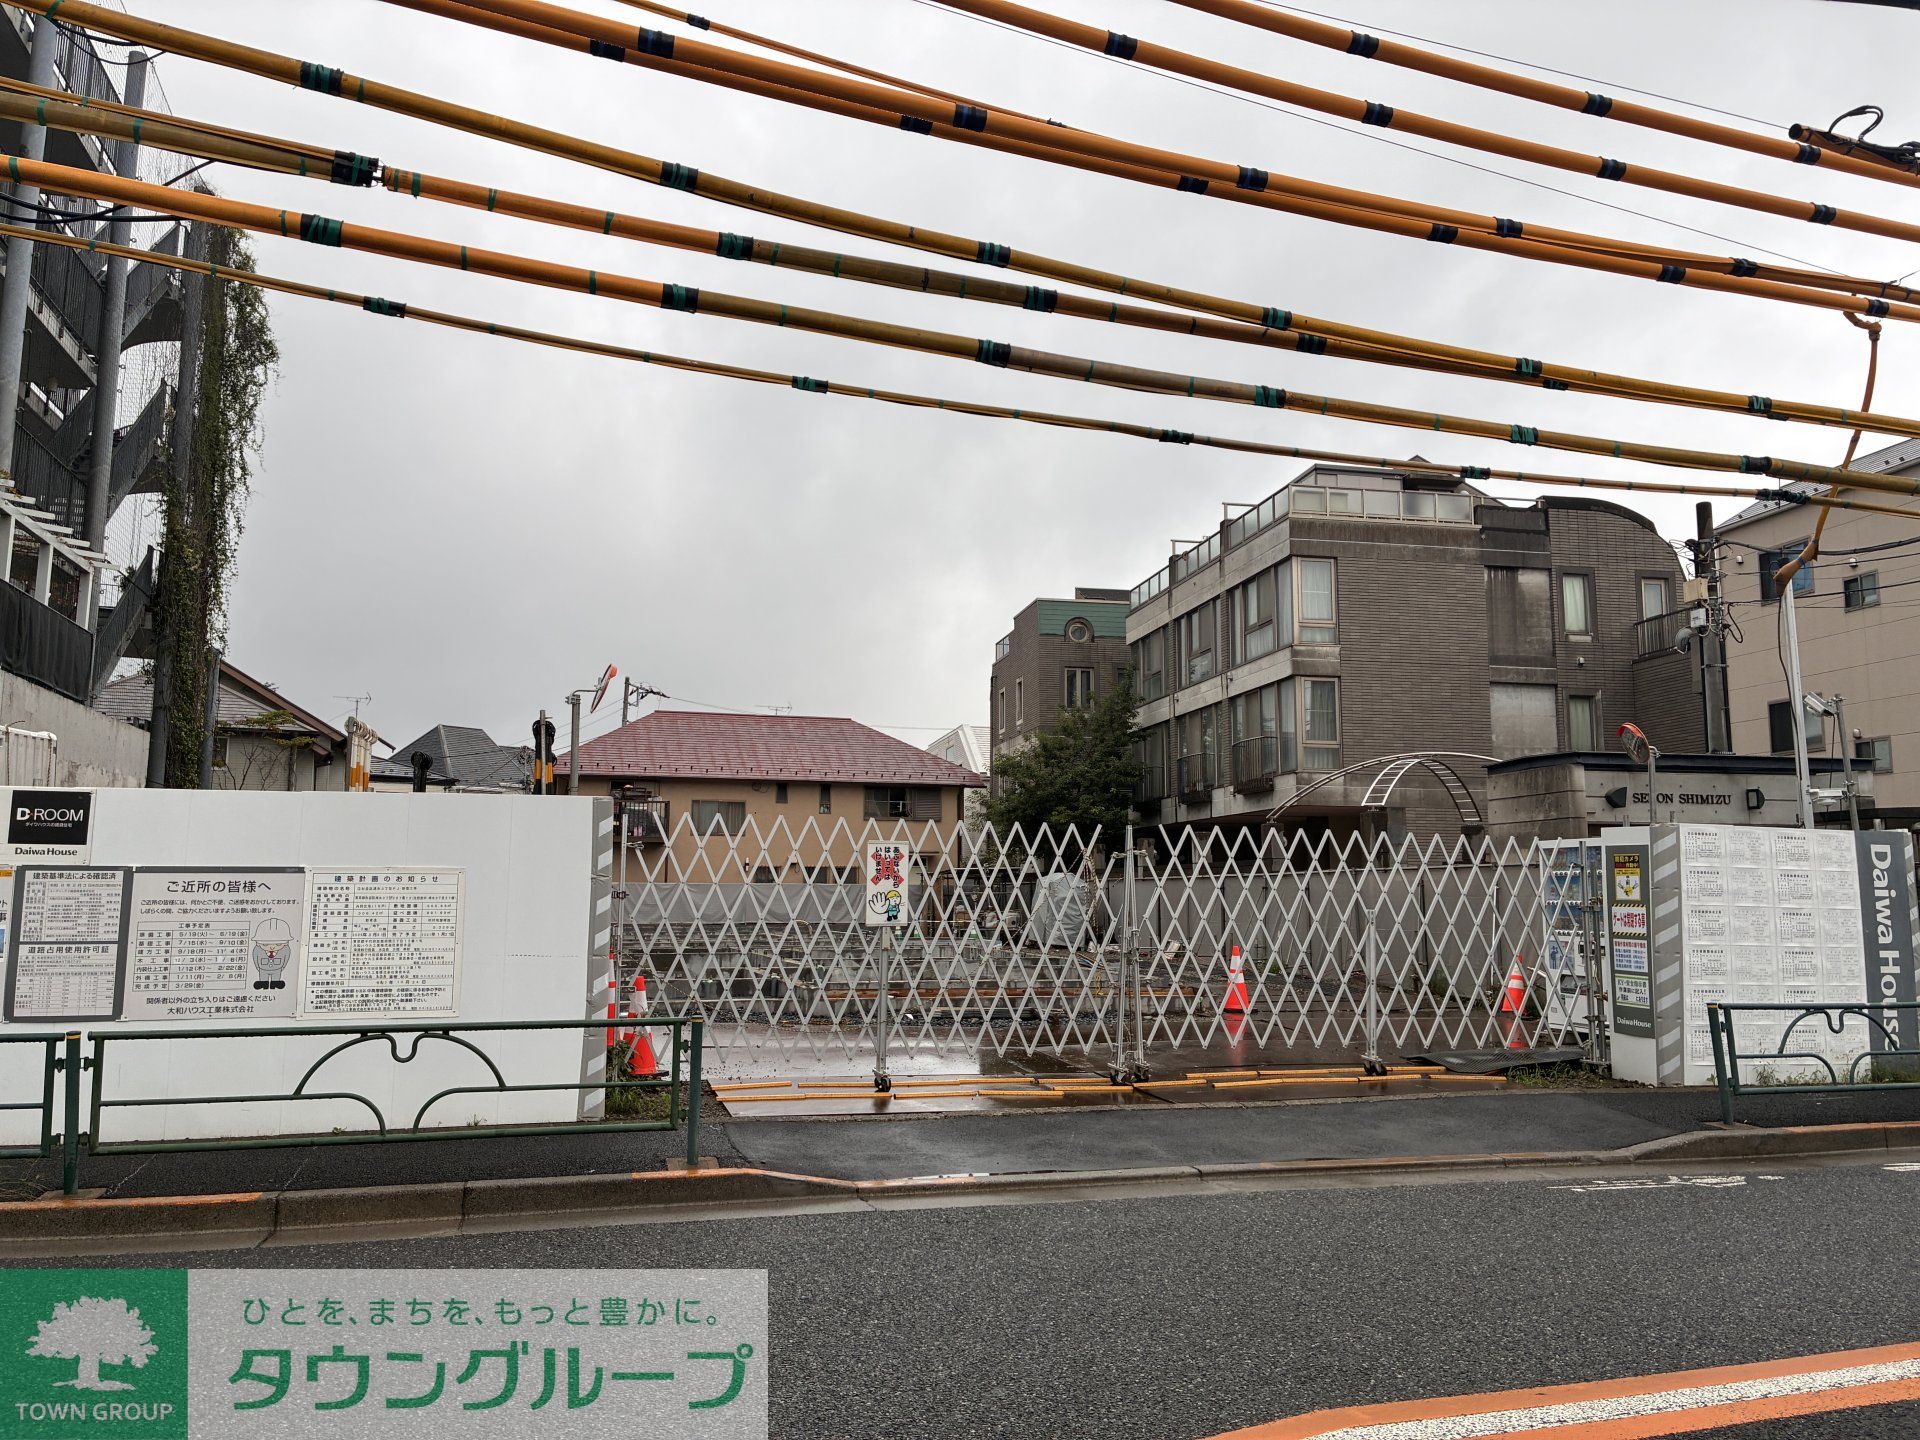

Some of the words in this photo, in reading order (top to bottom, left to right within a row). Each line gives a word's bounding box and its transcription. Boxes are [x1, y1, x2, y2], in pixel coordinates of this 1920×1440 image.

[1632, 793, 1673, 804] SEON
[1678, 794, 1731, 805] SHIMIZU
[15, 847, 45, 856] Daiwa
[46, 847, 78, 856] House
[33, 872, 117, 880] 建築基準法による確認済
[334, 875, 439, 883] 建築計画のお知らせ
[167, 880, 272, 893] ご近所の皆様へ
[1870, 844, 1897, 944] Daiwa
[146, 995, 276, 1005] 関係者以外の立ち入りはご遠慮ください
[167, 1005, 255, 1015] 大和ハウス工業株式会社
[1616, 1016, 1633, 1025] Daiwa
[1633, 1019, 1652, 1028] House
